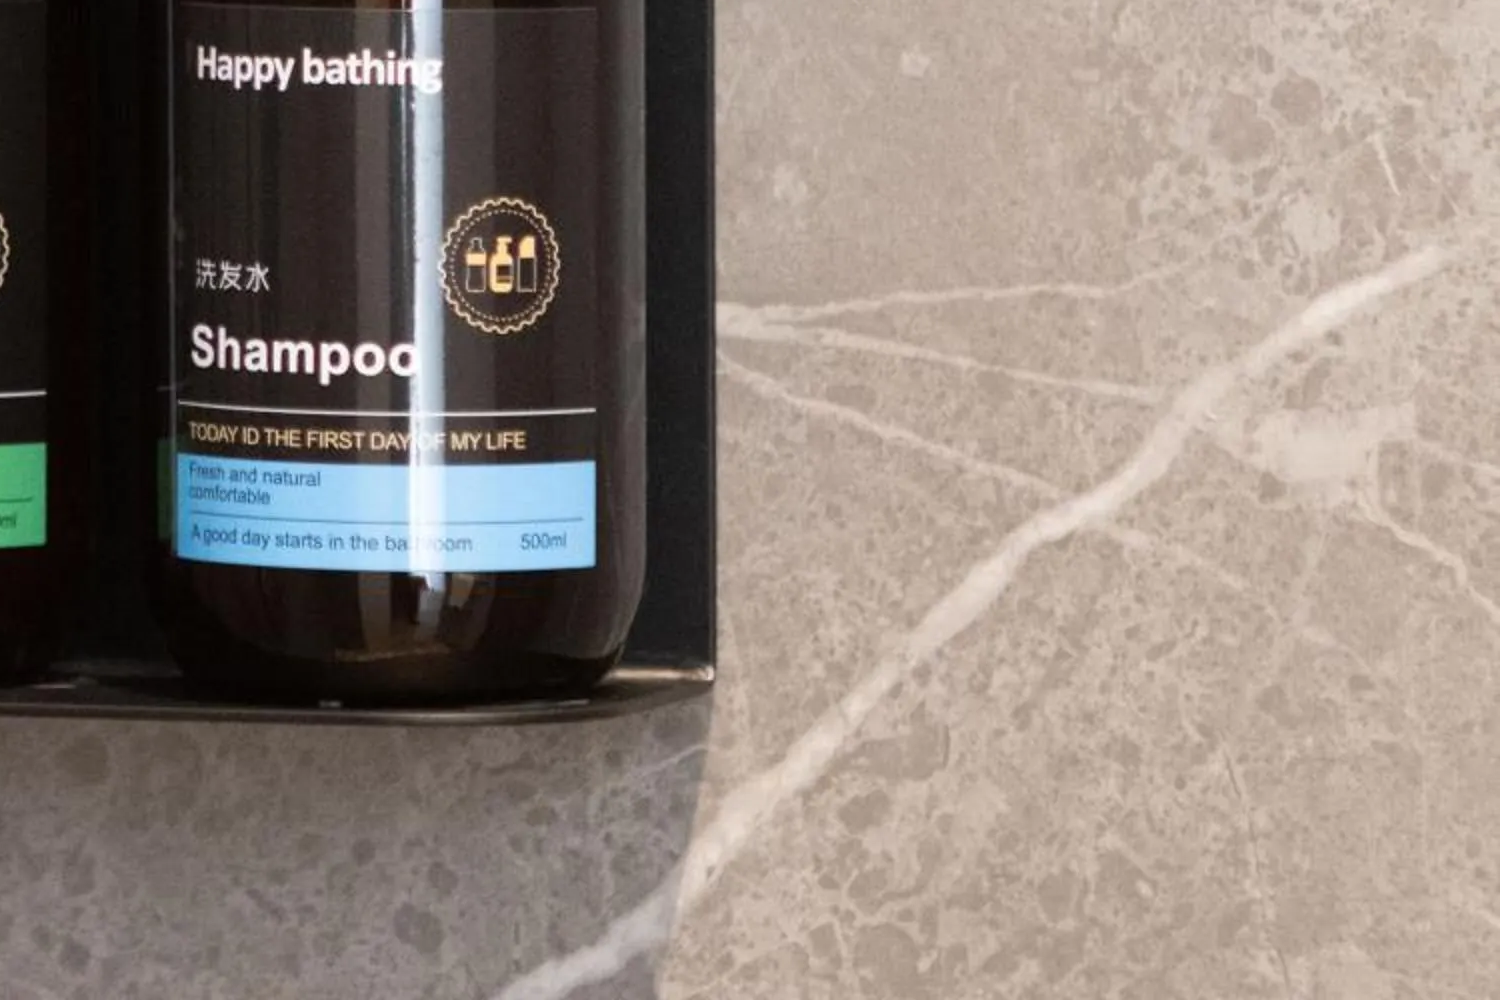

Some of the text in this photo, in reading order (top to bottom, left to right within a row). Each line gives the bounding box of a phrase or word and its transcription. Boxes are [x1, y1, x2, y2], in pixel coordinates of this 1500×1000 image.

[196, 45, 443, 94] Happy bathing
[195, 257, 271, 294] 洗发水
[190, 322, 421, 387] Shampoo
[189, 421, 527, 452] TODAY ID THE FIRST DAY OF MY LIFE
[189, 463, 322, 488] Fresh and natural
[189, 485, 270, 505] comfortable
[190, 524, 201, 542] A
[203, 528, 238, 548] good
[242, 529, 270, 551] day
[274, 531, 323, 551] starts
[328, 532, 347, 551] in
[350, 534, 379, 552] the
[520, 531, 567, 551] 500ml
